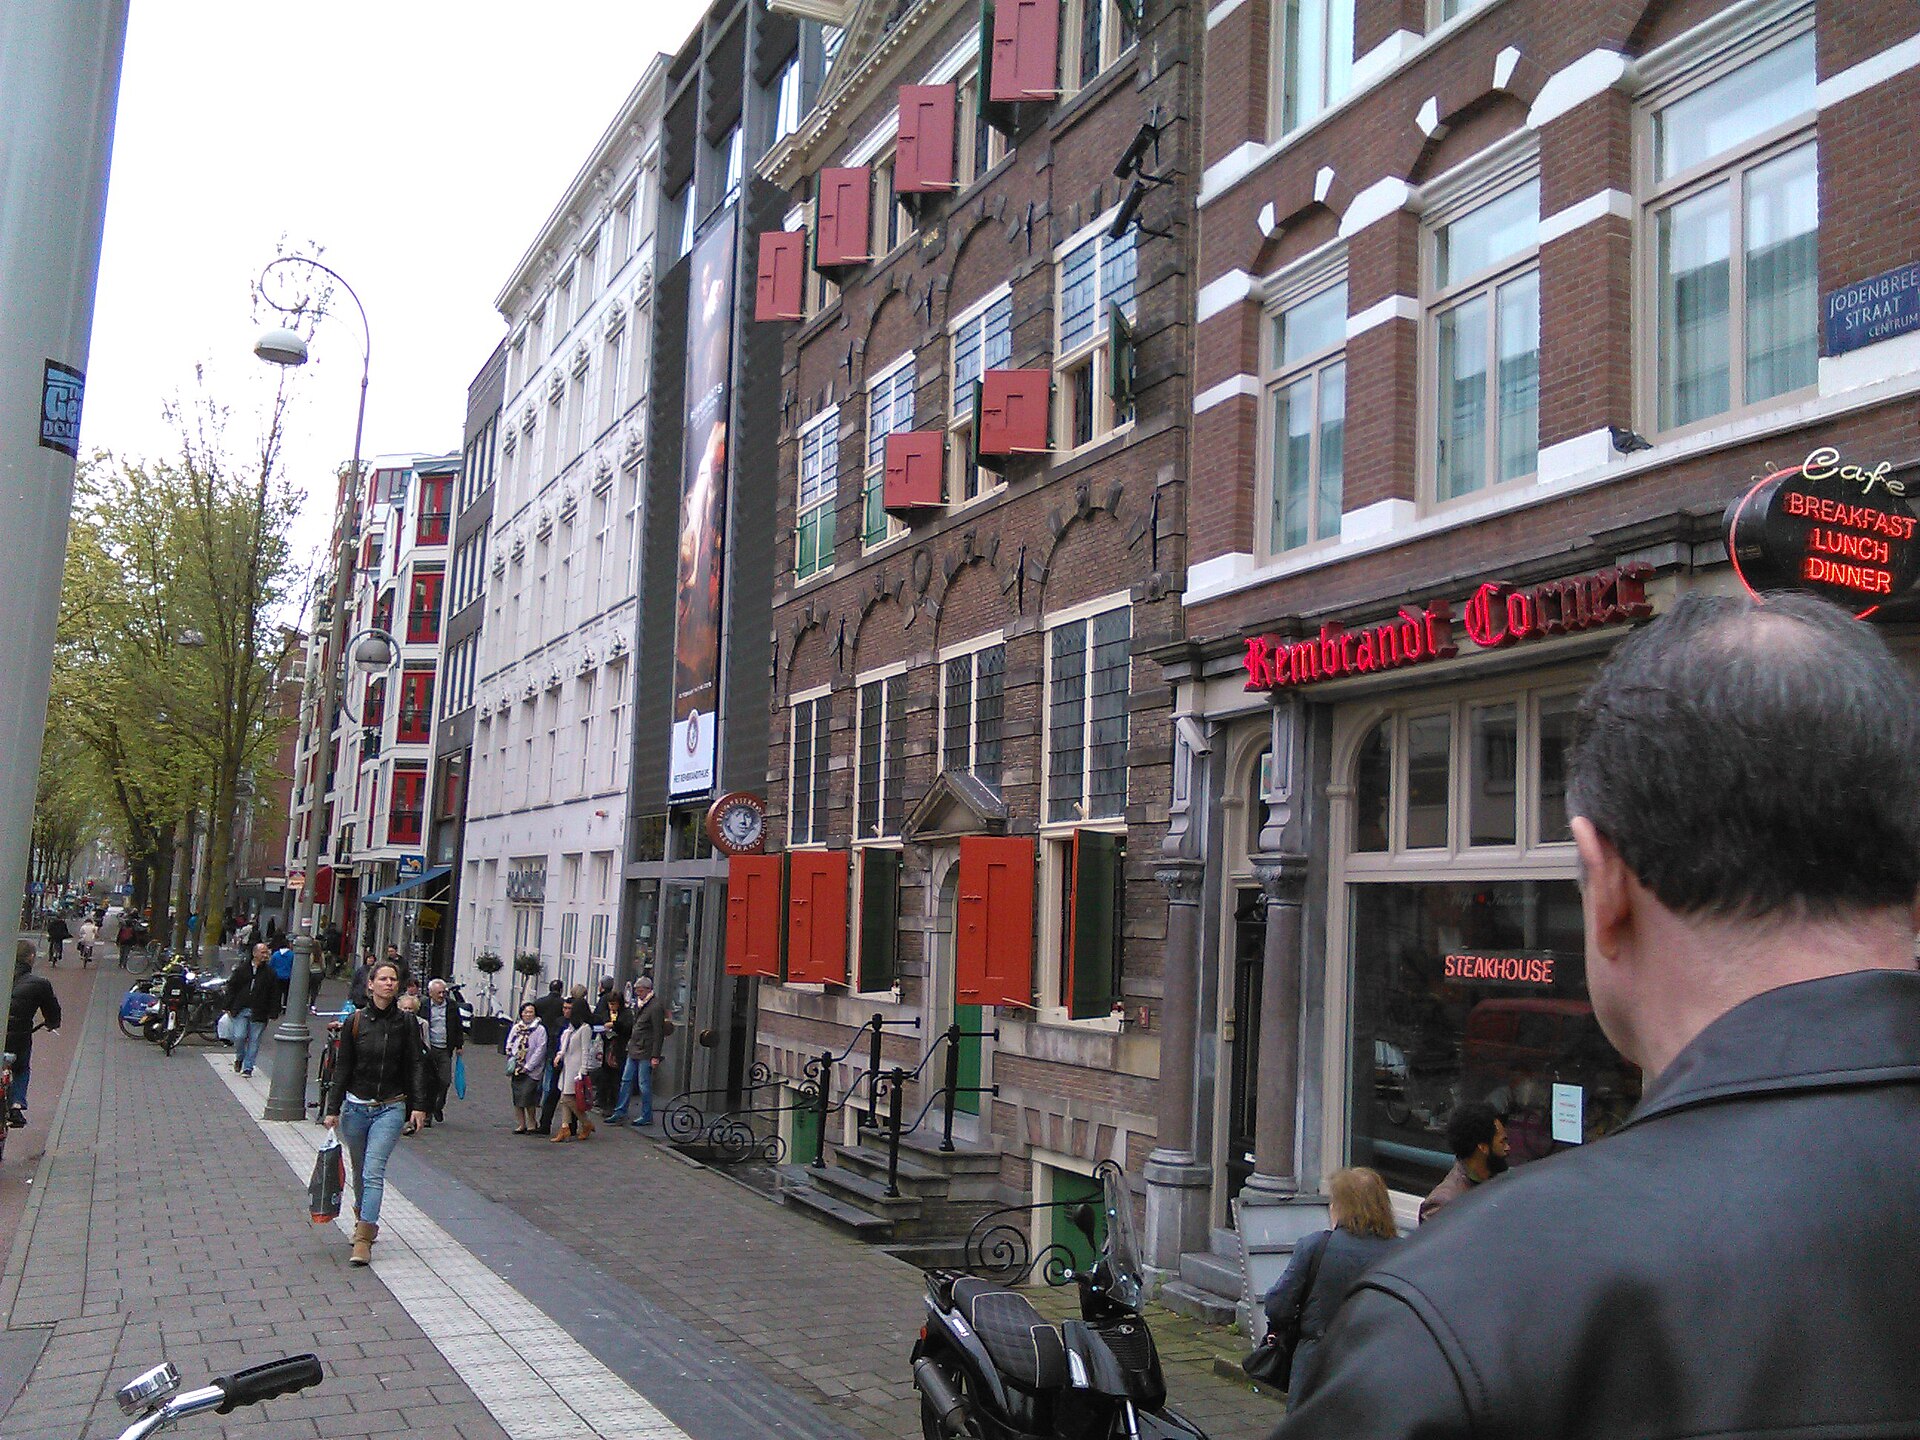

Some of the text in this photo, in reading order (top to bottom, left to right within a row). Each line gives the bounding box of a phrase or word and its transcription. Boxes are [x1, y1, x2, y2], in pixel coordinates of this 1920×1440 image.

[1830, 268, 1919, 319] JODENBREE
[1845, 295, 1902, 331] STRAAT
[1868, 312, 1918, 337] CENTRUM
[1788, 491, 1917, 540] BREAKFAST
[1813, 527, 1889, 564] LUNCH
[1808, 557, 1892, 594] DINNER
[1243, 561, 1657, 693] Rembrandt Corner
[1444, 954, 1555, 984] STEAKHOUSE
